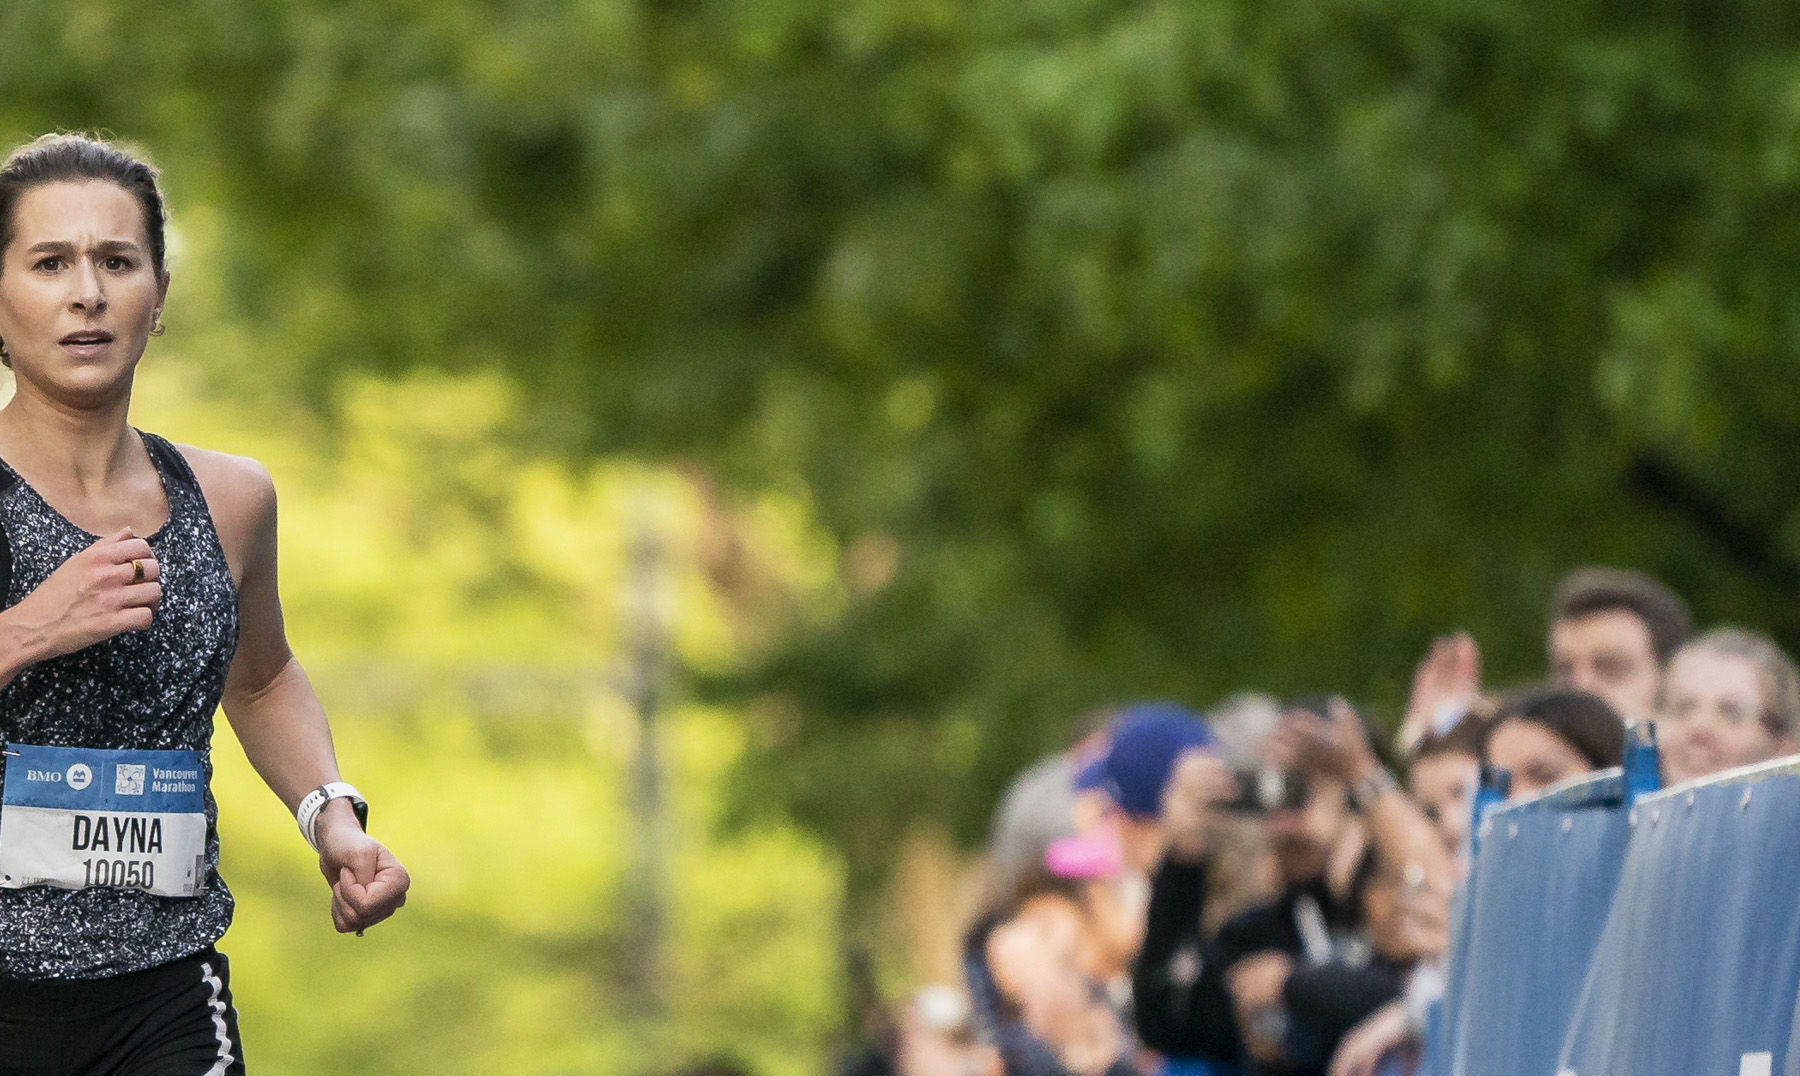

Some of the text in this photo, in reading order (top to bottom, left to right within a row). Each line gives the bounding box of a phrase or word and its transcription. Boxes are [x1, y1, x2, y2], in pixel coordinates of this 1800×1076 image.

[26, 770, 62, 783] BMO
[152, 767, 198, 780] Vancouver
[151, 780, 196, 793] Marathon
[72, 815, 163, 854] DAYNA
[82, 858, 154, 889] 10050
